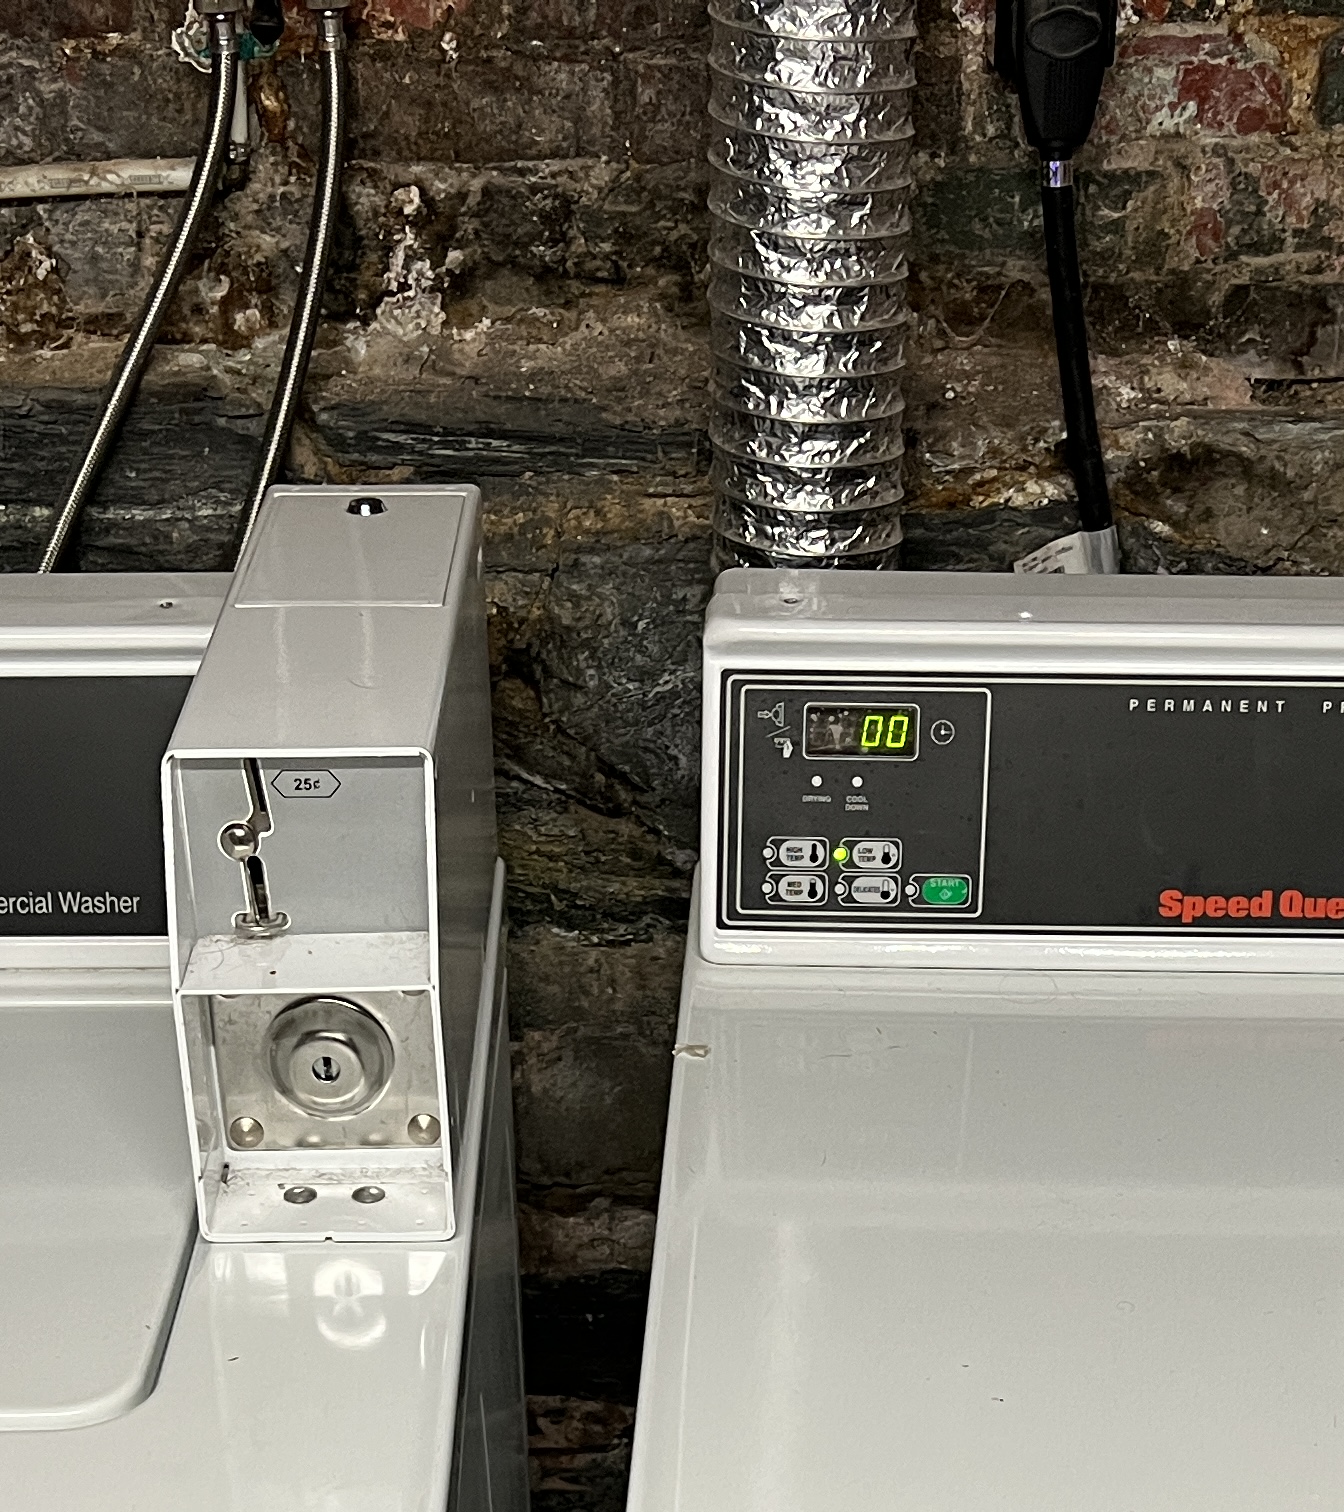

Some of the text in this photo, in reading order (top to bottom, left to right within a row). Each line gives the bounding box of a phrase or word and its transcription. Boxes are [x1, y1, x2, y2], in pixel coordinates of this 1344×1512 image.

[1128, 699, 1286, 714] PERMANENT
[293, 777, 321, 791] 25¢
[846, 795, 869, 803] COOL
[930, 879, 960, 888] START
[58, 891, 141, 914] Washer
[1158, 889, 1273, 923] Speed
